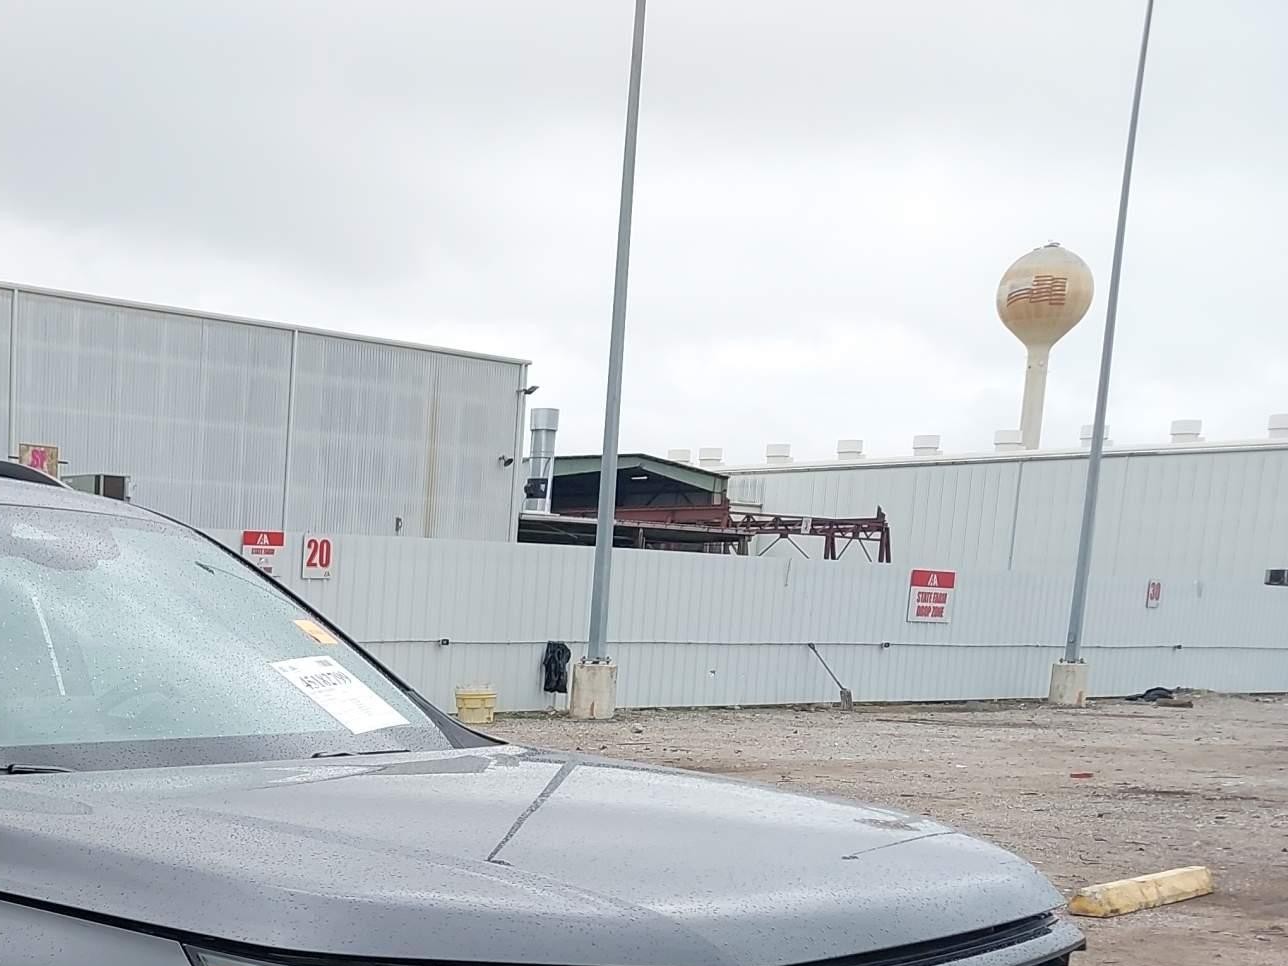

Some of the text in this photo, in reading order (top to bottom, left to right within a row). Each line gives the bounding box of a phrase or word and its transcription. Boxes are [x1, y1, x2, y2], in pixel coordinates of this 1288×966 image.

[306, 539, 331, 568] 20
[917, 591, 932, 603] STATE
[1149, 582, 1161, 601] 30
